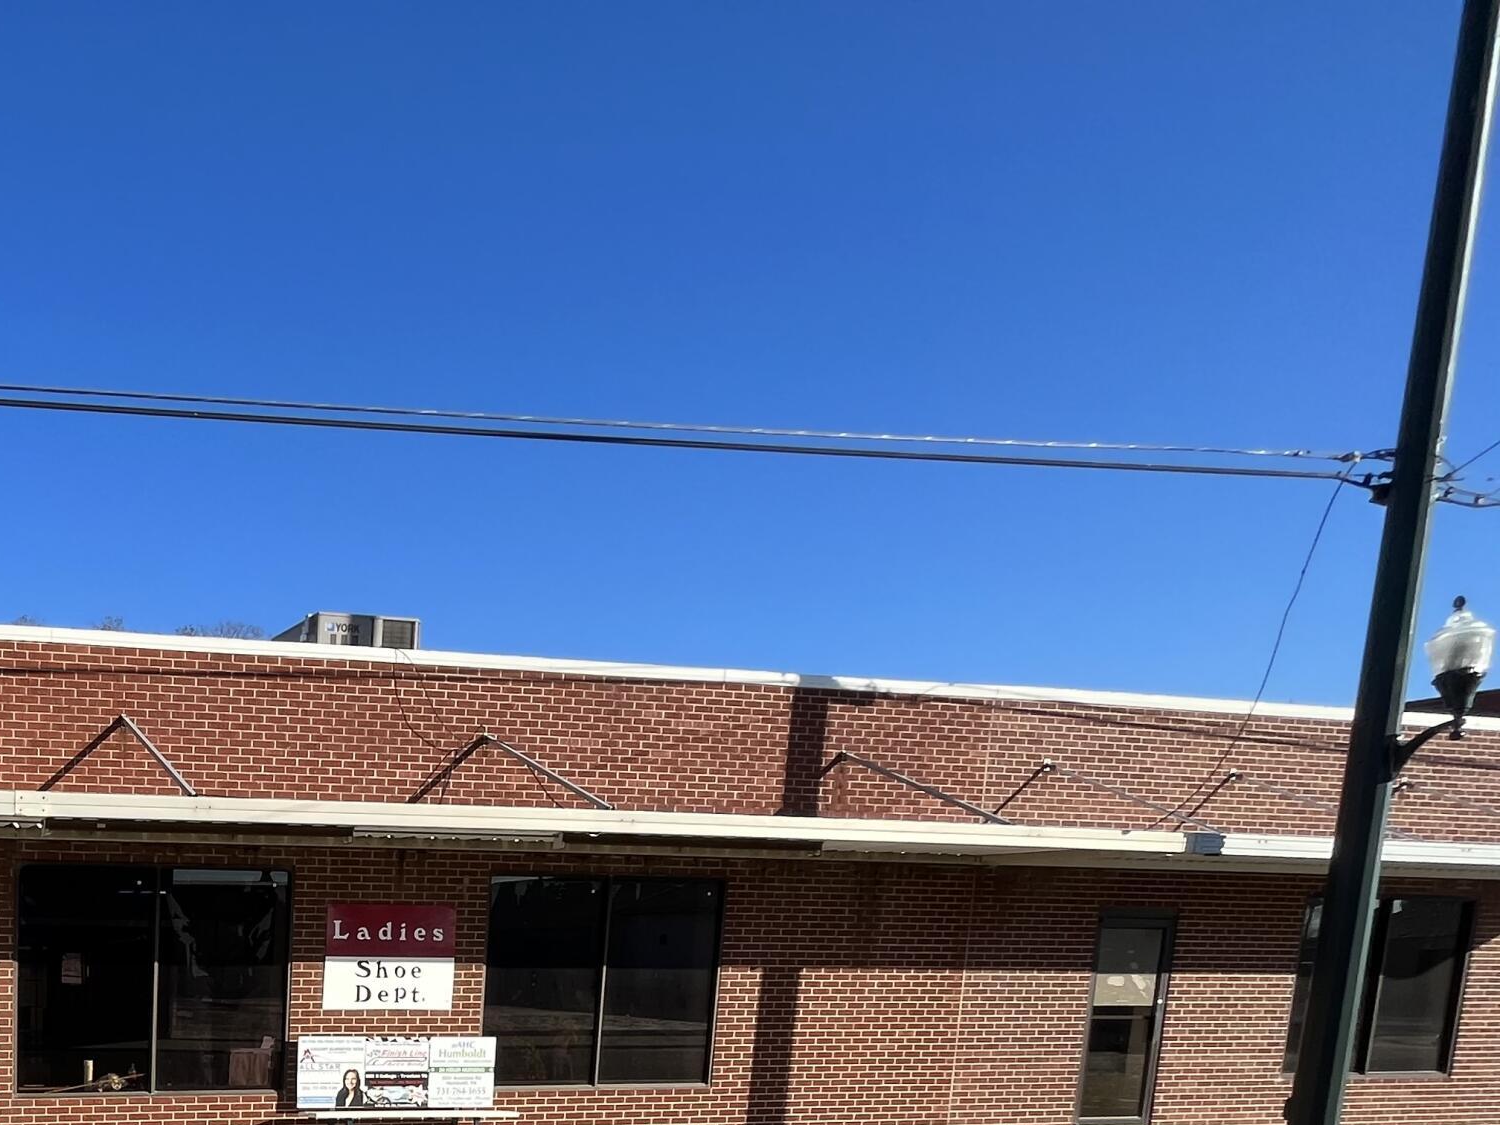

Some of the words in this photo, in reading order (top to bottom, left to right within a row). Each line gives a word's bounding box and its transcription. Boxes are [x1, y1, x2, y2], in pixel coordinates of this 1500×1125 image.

[336, 623, 360, 633] YORK
[332, 919, 445, 942] Ladies
[354, 959, 422, 979] Shoe
[354, 984, 426, 1004] Dept.
[381, 1049, 408, 1057] Finish
[409, 1049, 428, 1057] Line
[438, 1048, 487, 1058] Humboldt
